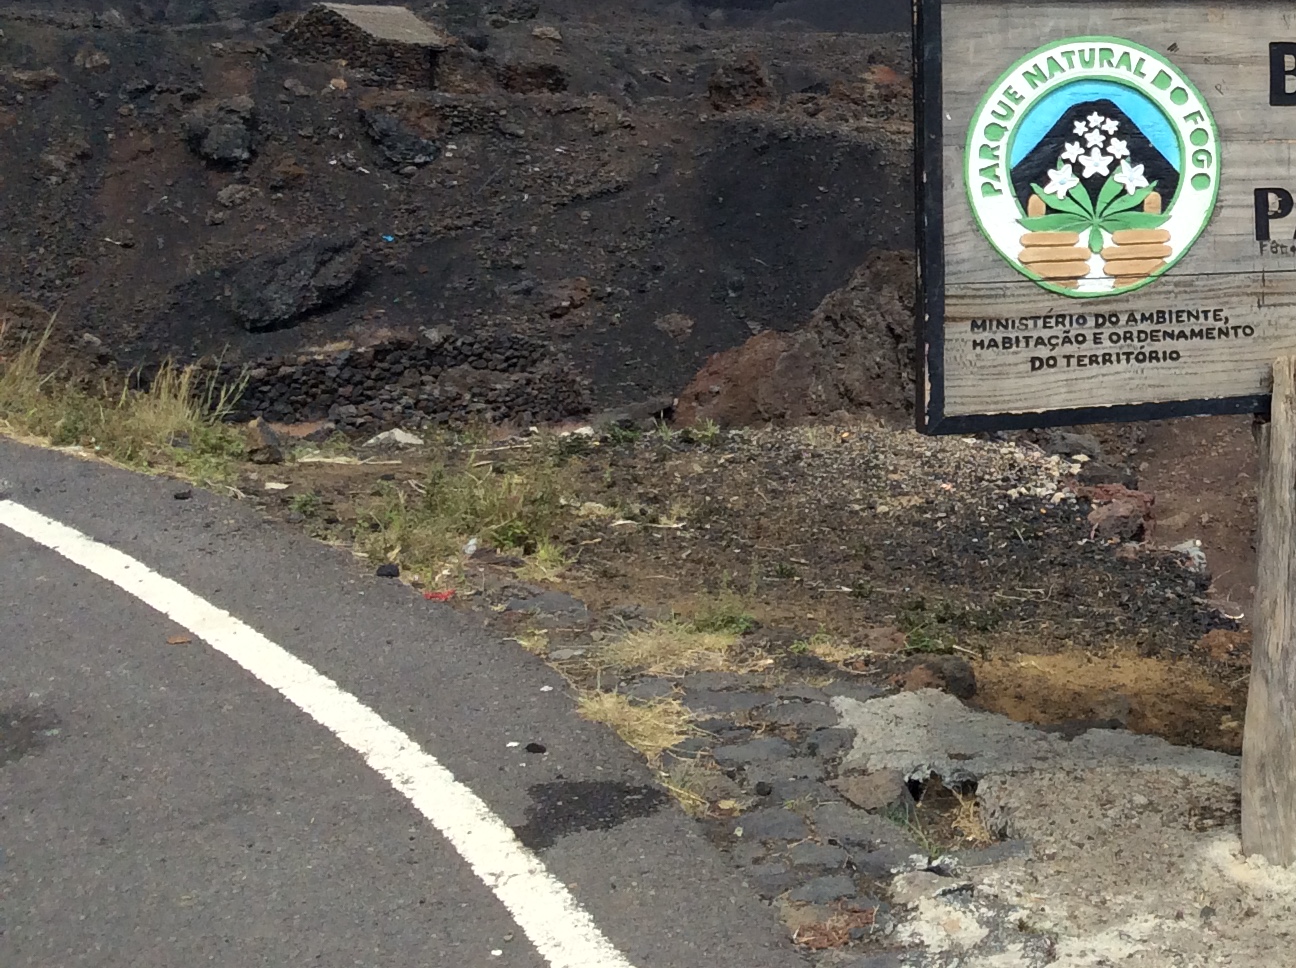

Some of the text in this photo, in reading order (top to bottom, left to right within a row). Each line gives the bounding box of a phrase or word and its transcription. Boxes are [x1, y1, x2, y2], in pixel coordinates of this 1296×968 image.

[978, 47, 1213, 199] PARQUE NATURAL DO FOGO
[970, 308, 1230, 332] MINISTÉRIO DO AMBIENTE,
[971, 325, 1255, 352] HABITAÇÃO E ORDENAMENTO
[1030, 345, 1182, 373] DO TERRITÓRIO
